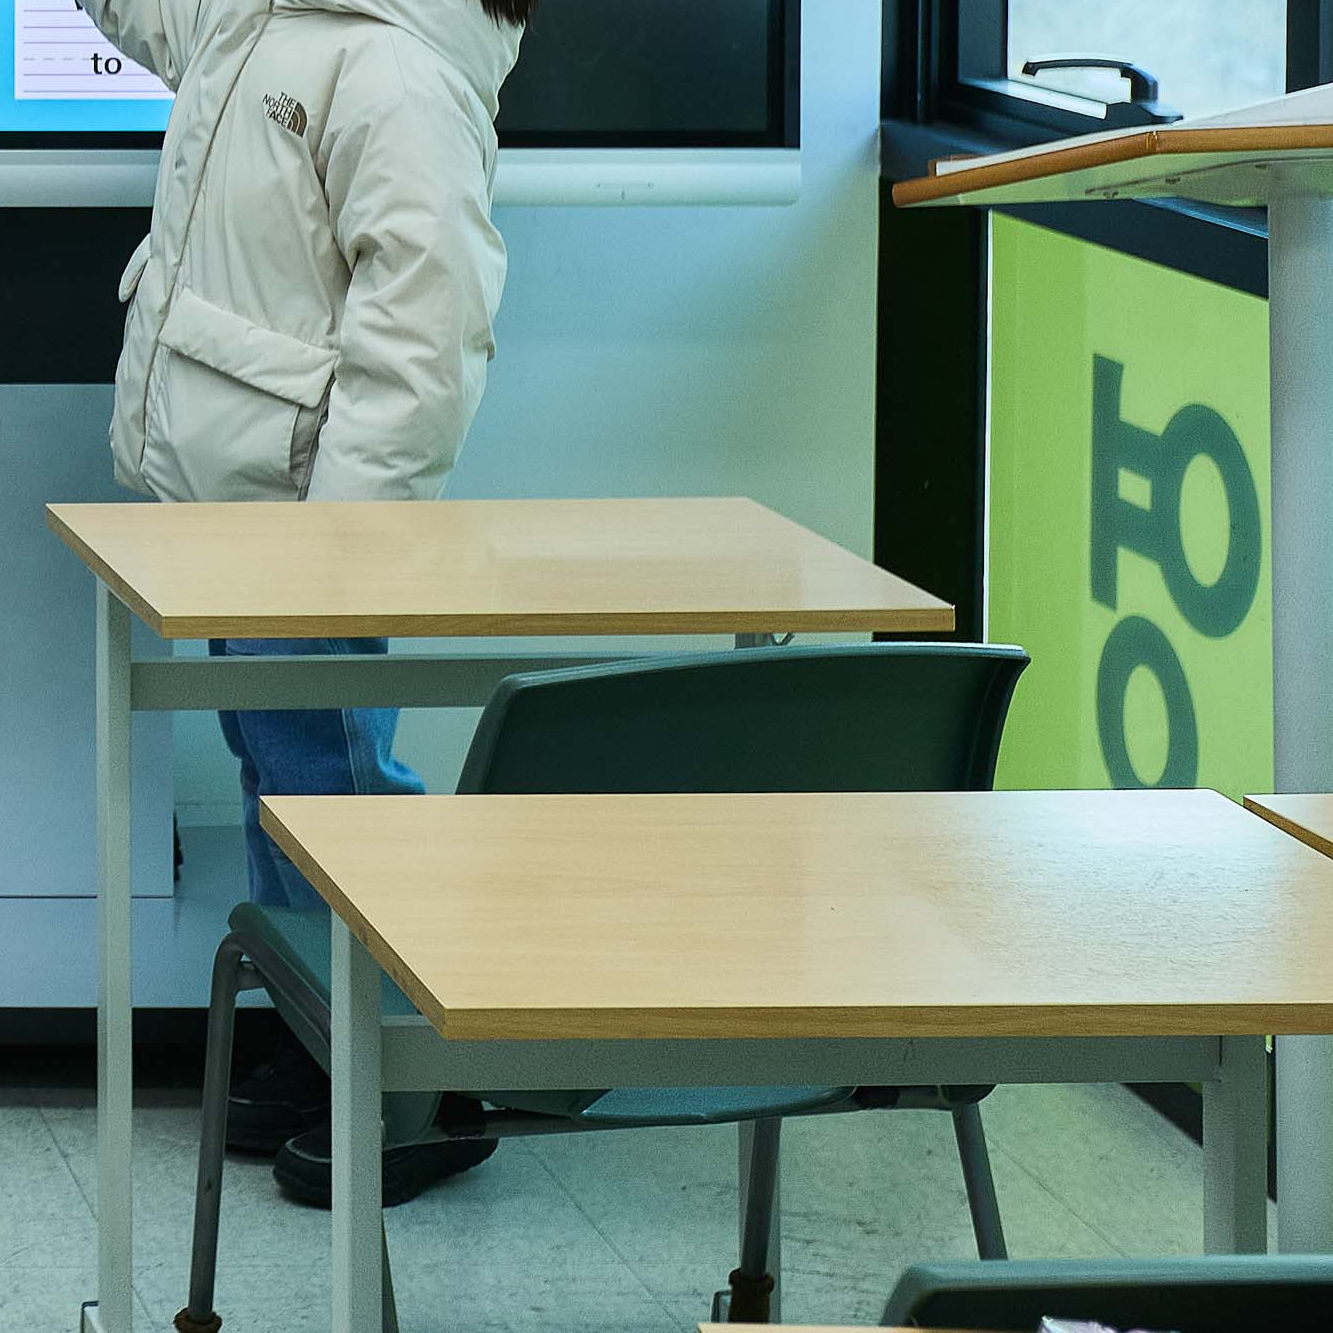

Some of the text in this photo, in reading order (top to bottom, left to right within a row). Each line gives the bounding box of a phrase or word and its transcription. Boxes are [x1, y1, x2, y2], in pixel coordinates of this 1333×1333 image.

[90, 52, 123, 76] to
[262, 93, 293, 118] NORTH
[279, 91, 297, 106] THE
[266, 108, 288, 127] FACE
